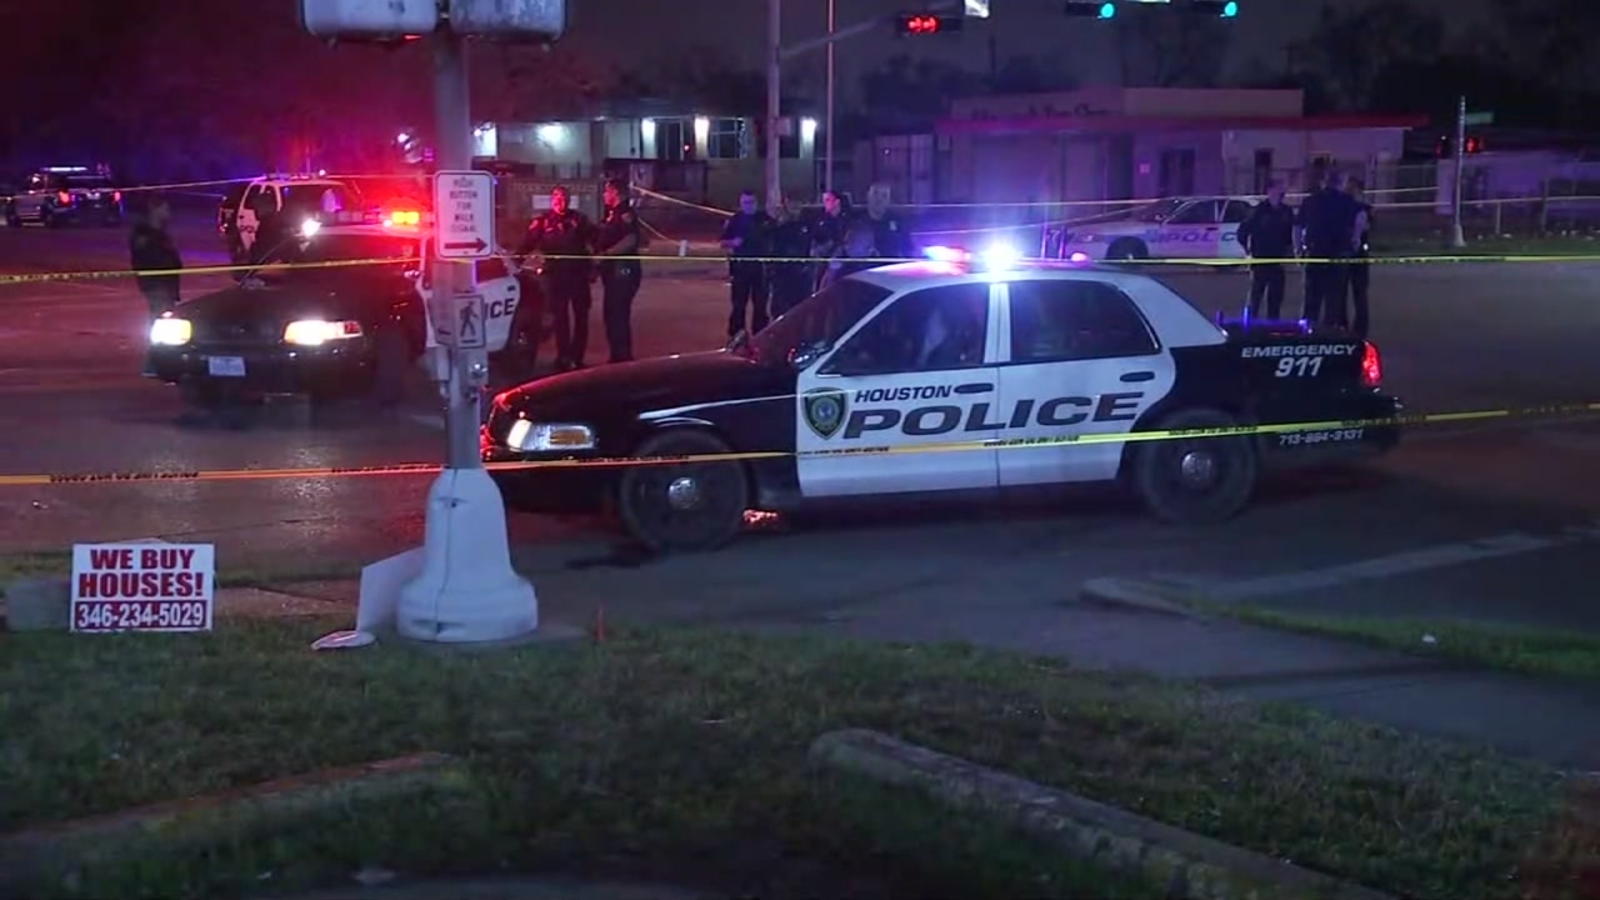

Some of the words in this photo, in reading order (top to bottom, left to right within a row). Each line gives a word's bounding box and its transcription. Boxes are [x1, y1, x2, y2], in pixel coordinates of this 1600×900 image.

[484, 297, 515, 319] ICE
[1241, 344, 1356, 358] EMERGENCY
[1274, 356, 1323, 377] 911
[854, 384, 953, 403] HOUSTON
[842, 391, 1145, 440] POLICE
[90, 549, 134, 570] WE
[140, 549, 195, 570] BUY
[78, 572, 204, 598] HOUSES!
[77, 602, 204, 627] 346-234-5029
